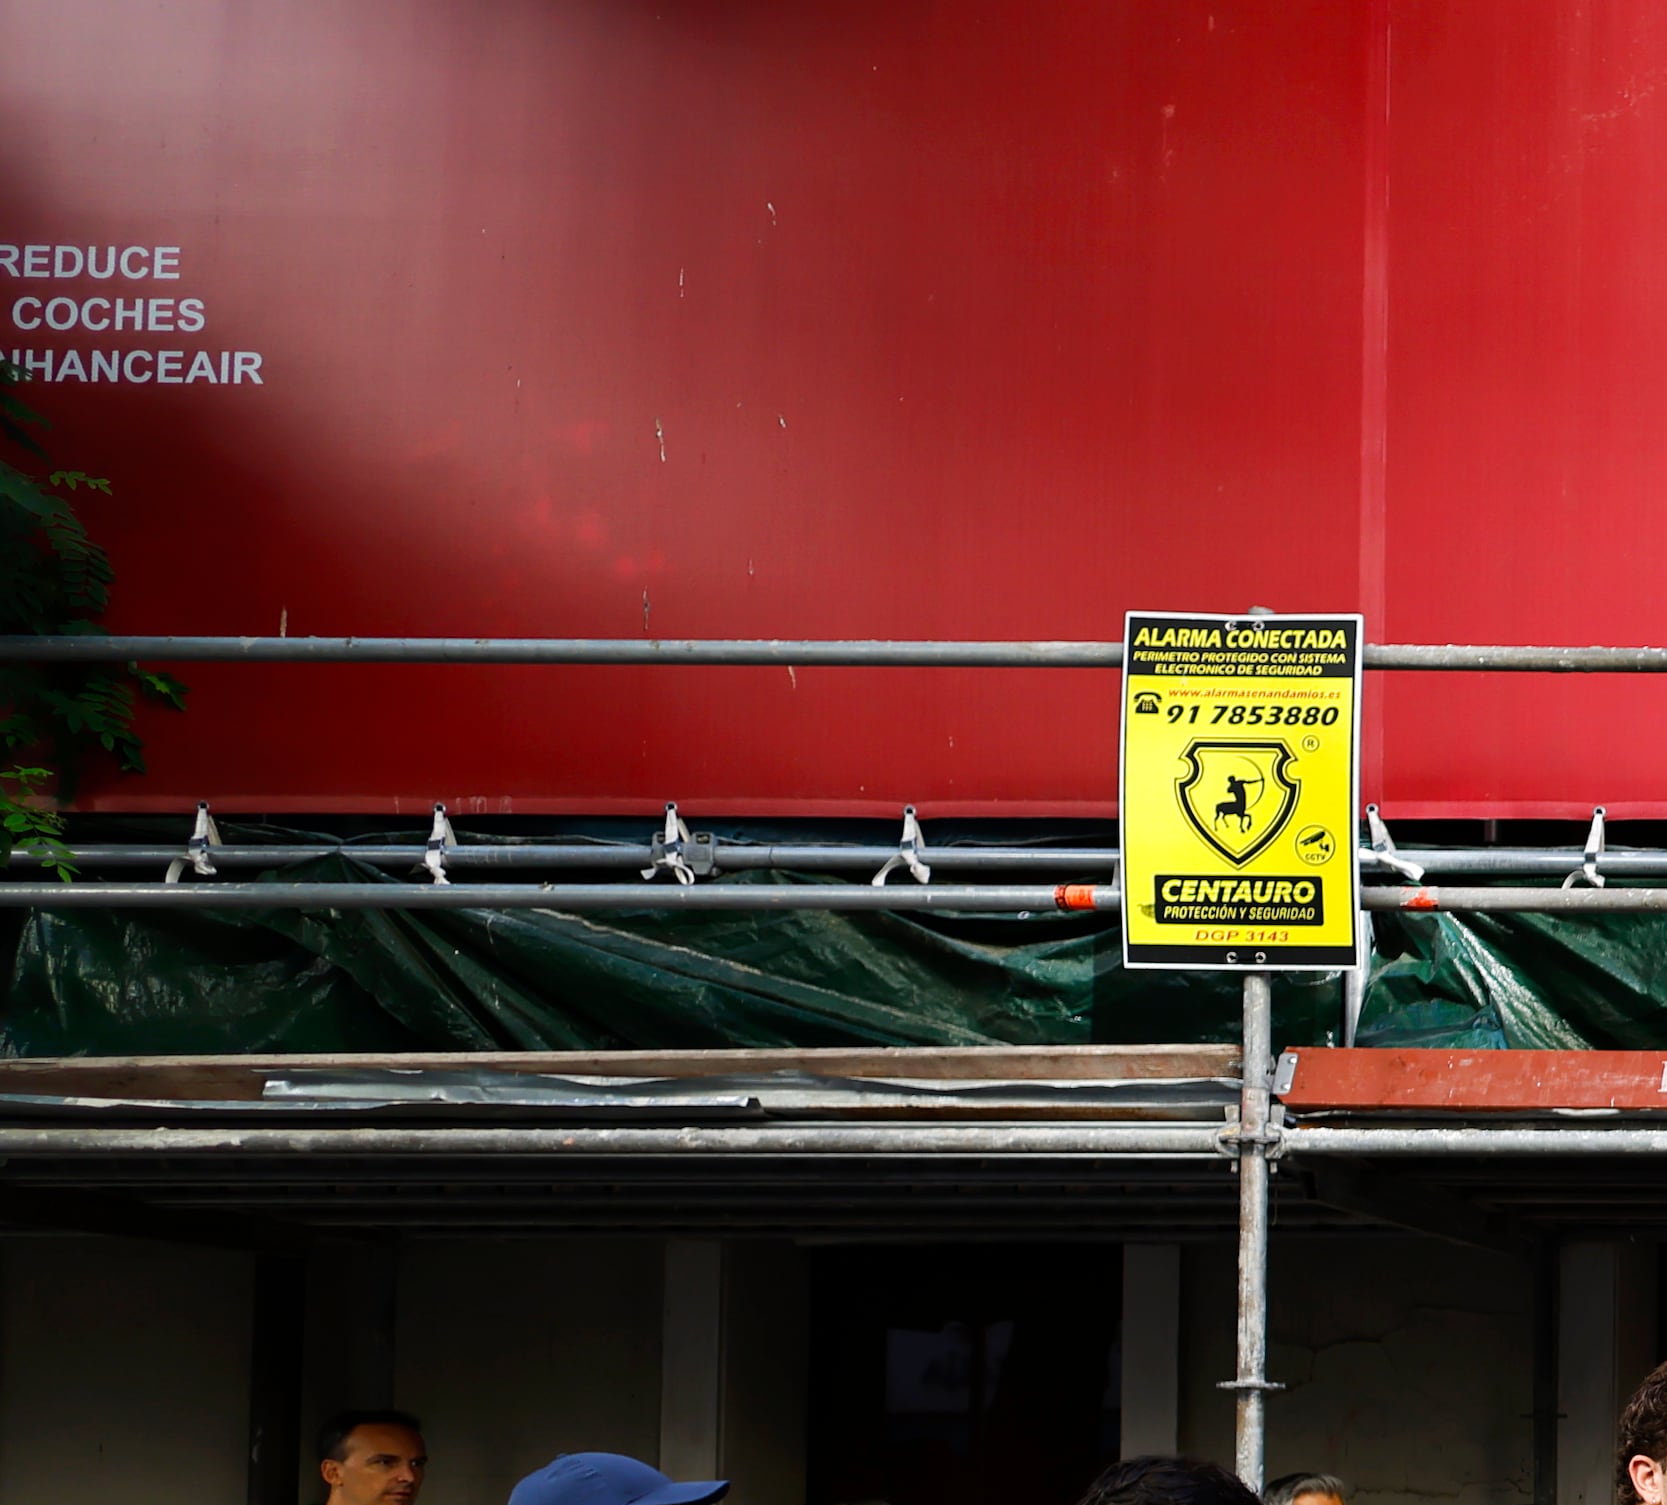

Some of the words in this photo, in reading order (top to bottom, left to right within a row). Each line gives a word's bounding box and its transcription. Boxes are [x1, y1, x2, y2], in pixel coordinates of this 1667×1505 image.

[12, 296, 205, 331] COCHES
[1134, 628, 1222, 648] ALARMA
[1226, 629, 1347, 649] CONECTADA
[1133, 651, 1200, 662] PERIMETRO
[1201, 652, 1269, 663] PROTEGIDO
[1270, 653, 1297, 663] CON
[1299, 653, 1346, 664] SISTEMA
[1237, 664, 1253, 675] DE
[1255, 664, 1322, 675] SEGURIDAD
[1167, 704, 1200, 724] 91
[1210, 705, 1339, 726] 7853880
[1161, 879, 1316, 904] CENTAURO
[1163, 904, 1238, 919] PROTECCIÓN
[1239, 906, 1246, 919] Y
[1249, 906, 1315, 920] SEGURIDAD
[1195, 930, 1239, 941] DGP
[1245, 931, 1289, 942] 3143
